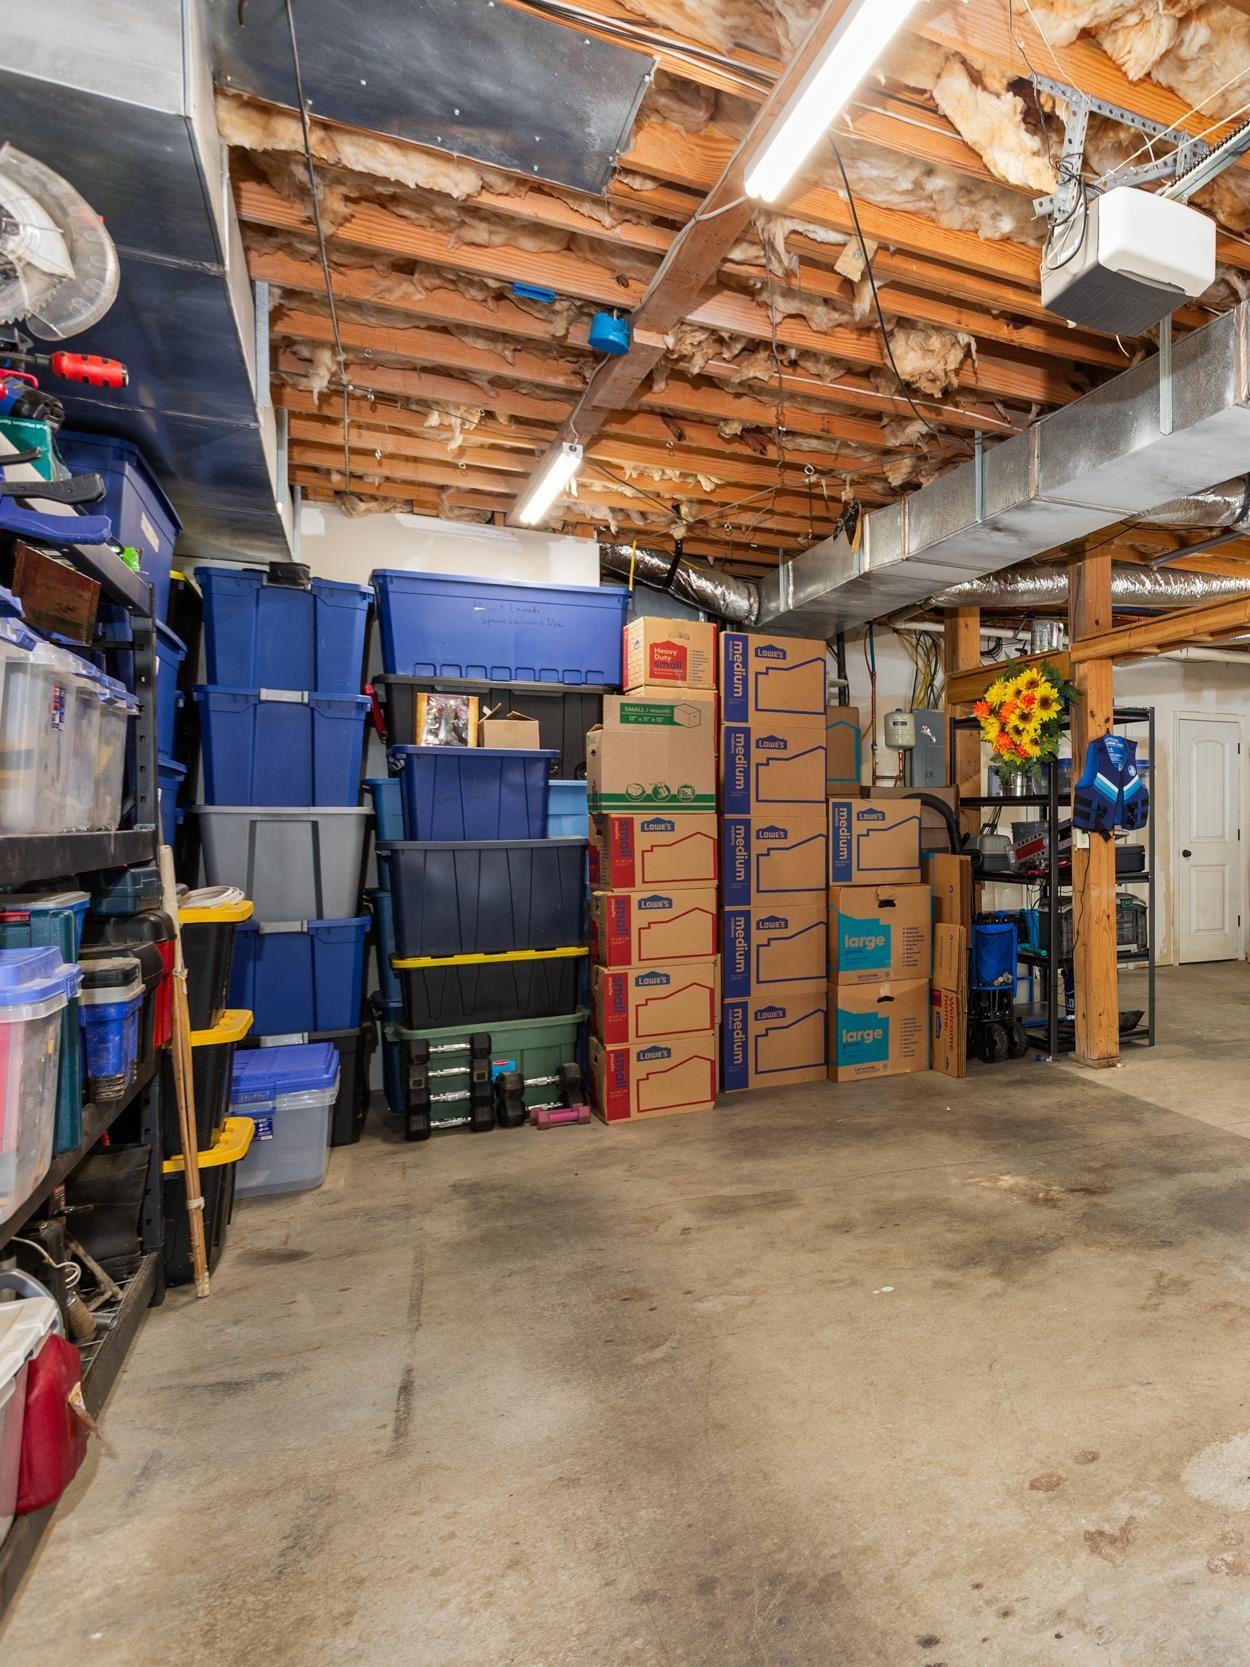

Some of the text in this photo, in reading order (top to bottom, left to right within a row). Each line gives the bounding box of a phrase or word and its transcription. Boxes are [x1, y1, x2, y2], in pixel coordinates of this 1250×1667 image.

[653, 647, 678, 657] Heavy
[653, 653, 672, 662] Duty
[734, 640, 746, 697] medium
[735, 733, 748, 789] medium
[620, 819, 634, 857] small
[839, 807, 851, 860] medium
[735, 825, 748, 881] medium
[615, 898, 629, 936] small
[735, 916, 748, 973] medium
[844, 934, 886, 951] large
[612, 975, 626, 1013] small
[733, 1007, 746, 1064] medium
[842, 1028, 884, 1044] large
[615, 1051, 629, 1088] small
